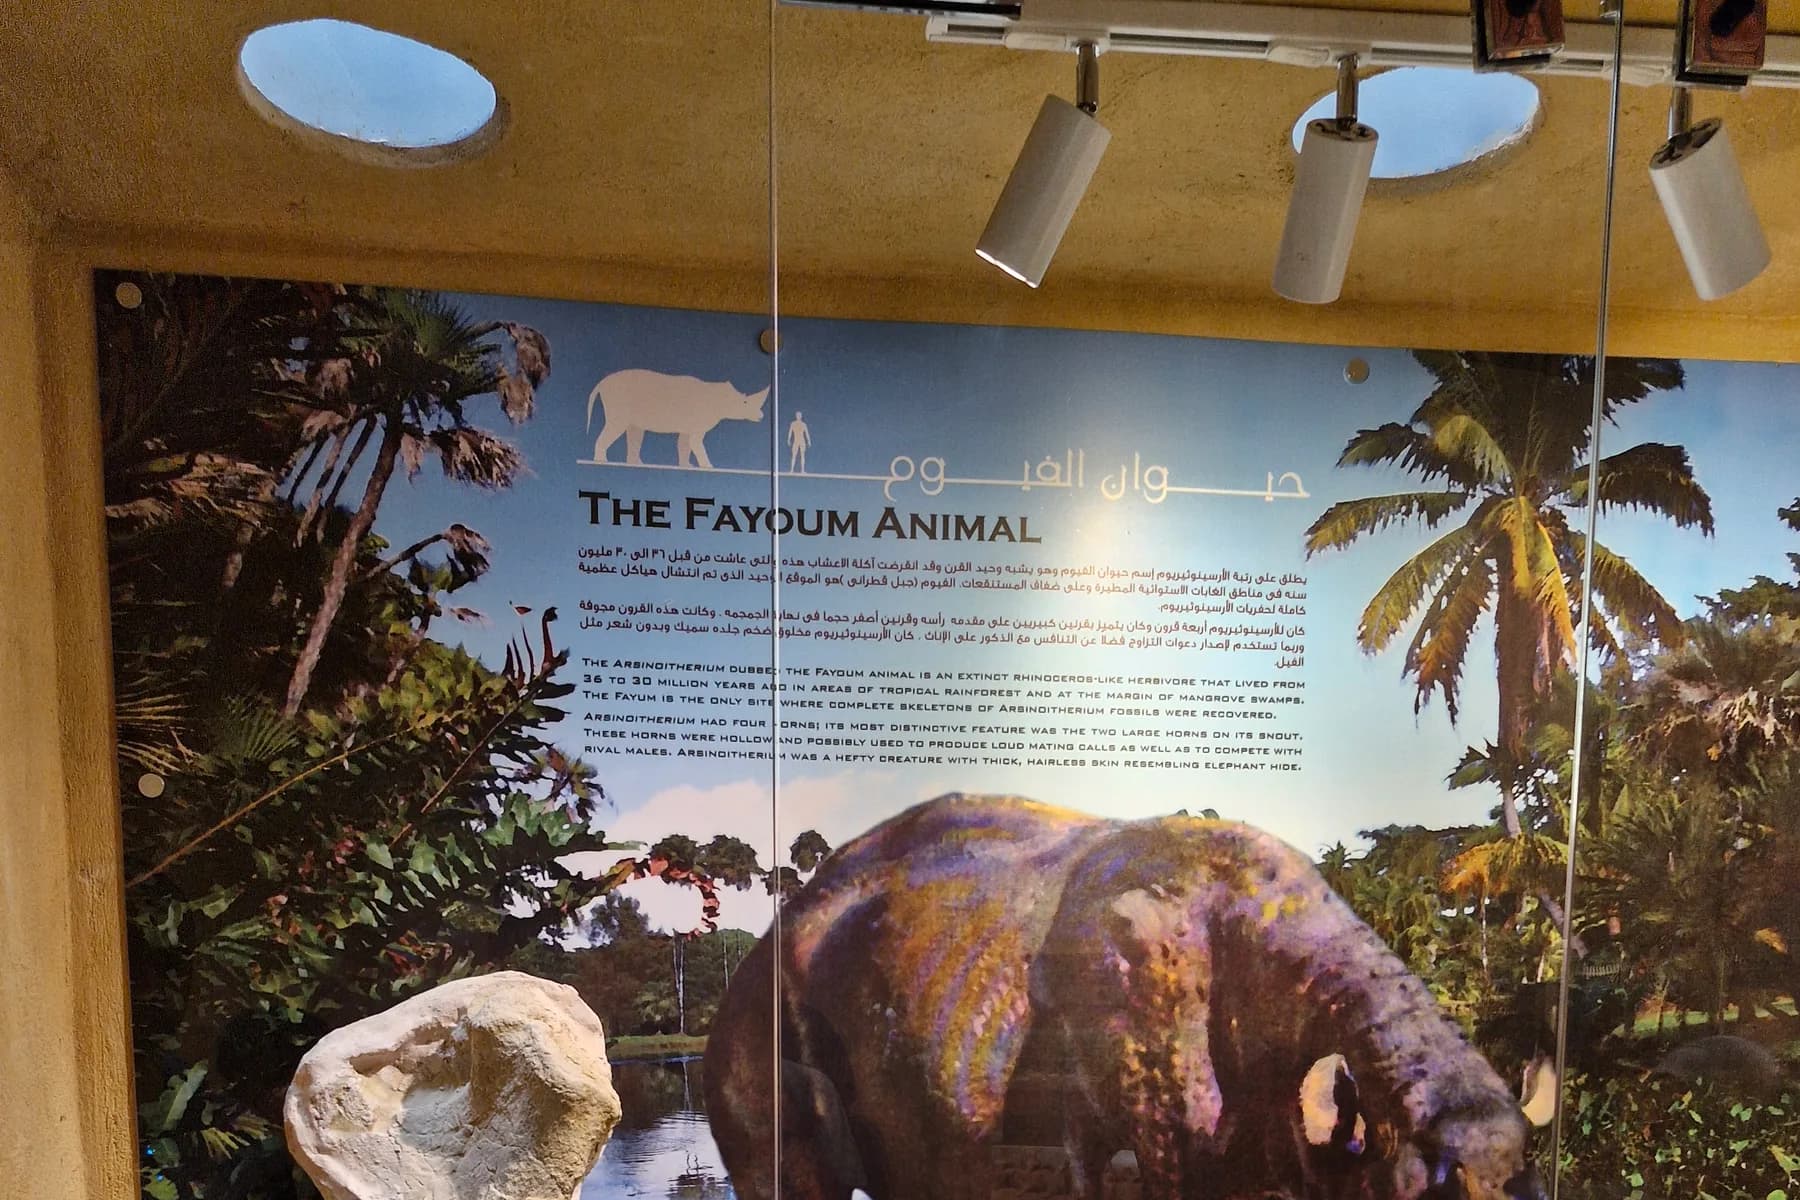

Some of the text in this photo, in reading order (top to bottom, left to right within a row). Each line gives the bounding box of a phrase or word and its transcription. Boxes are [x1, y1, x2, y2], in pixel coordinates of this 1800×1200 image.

[884, 448, 1311, 503] حيوان الفيوم
[578, 488, 1042, 544] THE FAYOUM ANIMAL
[578, 545, 612, 559] مليون
[651, 548, 665, 558] ٣٦
[668, 549, 691, 563] قبل
[713, 552, 746, 564] عاشت
[694, 554, 711, 564] من
[782, 558, 805, 567] هذه
[878, 559, 918, 572] انقرضت
[922, 560, 941, 573] وقد
[945, 562, 972, 574] القرن
[975, 565, 1002, 576] وحيد
[1005, 563, 1033, 576] يشبه
[1037, 566, 1058, 577] وهو
[1061, 565, 1095, 577] الفيوم
[1097, 566, 1129, 578] حيوان
[921, 576, 955, 590] الفيوم
[1233, 572, 1252, 584] رتبة
[1255, 571, 1276, 584] على
[1279, 573, 1307, 586] يطلق
[1030, 580, 1060, 591] ضفاف
[1063, 581, 1092, 594] وعلى
[1095, 582, 1135, 594] المطيرة
[1190, 585, 1226, 597] الغابات
[1229, 587, 1263, 600] مناطق
[1236, 603, 1275, 615] لحفريات
[1278, 605, 1306, 616] كاملة
[581, 657, 609, 668] THE
[612, 658, 726, 673] ARSINOITHERIUM
[785, 667, 811, 677] THE
[815, 667, 865, 678] FAYOUM
[868, 670, 916, 680] ANIMAL
[919, 671, 932, 680] IS
[935, 672, 953, 680] AN
[957, 672, 1009, 681] EXTINCT
[1013, 673, 1123, 684] RHINOCEROS-LIKE
[1128, 677, 1196, 686] HERBIVORE
[1200, 679, 1231, 687] THAT
[1235, 680, 1269, 688] LIVED
[1272, 681, 1305, 689] FROM
[583, 673, 603, 684] 36
[608, 676, 626, 685] TO
[631, 675, 652, 686] 30
[657, 678, 709, 689] MILLION
[714, 680, 756, 691] YEARS
[792, 683, 806, 692] IN
[810, 684, 852, 694] AREAS
[857, 685, 875, 694] OF
[879, 686, 940, 696] TROPICAL
[944, 688, 1022, 697] RAINFOREST
[1026, 690, 1052, 698] AND
[1077, 691, 1100, 699] THE
[1106, 692, 1153, 700] MARGIN
[1158, 693, 1174, 701] OF
[1179, 694, 1245, 704] MANGROVE
[1250, 695, 1305, 705] SWAMPS.
[581, 689, 1277, 720] THE FAYUM IS THE ONLY SITE WHERE COMPLETE SKELETONS OF ARSINOITHERIUM FOSSILS WERE RECOVERED.
[583, 711, 1303, 741] ARSINOITHERIUM HAD FOUR ORNS; ITS MOST DISTINCTIVE FEATURE WAS THE TWO LARGE HORNS ON ITS SNOUT.
[583, 727, 627, 739] THESE
[630, 730, 677, 741] HORNS
[680, 733, 717, 742] WERE
[719, 734, 772, 744] HOLLOW
[807, 737, 867, 747] POSSIBLY
[870, 739, 904, 748] USED
[907, 739, 925, 748] TO
[928, 740, 988, 750] PRODUCE
[991, 741, 1025, 750] LOUD
[1028, 743, 1074, 751] MATING
[1078, 743, 1116, 752] CALLS
[1120, 744, 1136, 752] AS
[1140, 745, 1171, 753] WELL
[1194, 746, 1211, 754] TO
[1214, 746, 1270, 756] COMPETE
[1273, 748, 1303, 756] WITH
[584, 745, 622, 755] RIVAL
[625, 746, 673, 757] MALES.
[790, 752, 818, 761] WAS
[822, 753, 831, 761] A
[835, 753, 876, 763] HEFTY
[879, 754, 943, 764] CREATURE
[947, 756, 978, 765] WITH
[982, 757, 1022, 767] THICK,
[1027, 758, 1086, 767] HAIRLESS
[1091, 759, 1119, 767] SKIN
[1124, 760, 1200, 769] RESEMBLING
[1204, 761, 1266, 770] ELEPHANT
[1270, 763, 1302, 771] HIDE.
